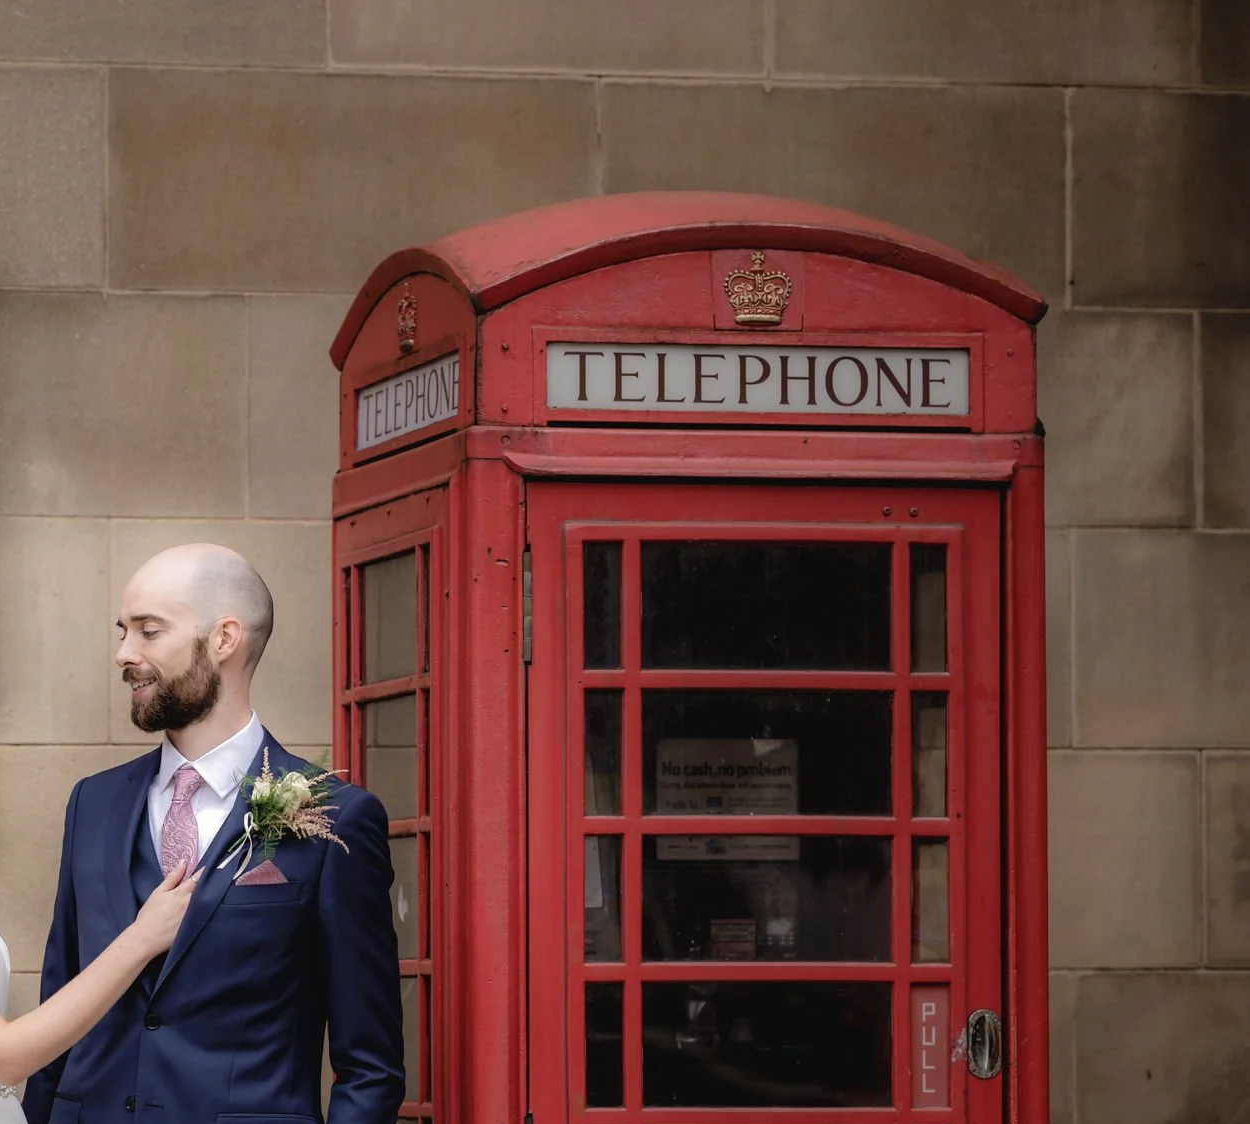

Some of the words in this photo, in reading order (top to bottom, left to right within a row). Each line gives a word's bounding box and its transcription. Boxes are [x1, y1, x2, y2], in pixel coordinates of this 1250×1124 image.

[363, 360, 460, 442] TELEPHONE
[563, 350, 952, 408] TELEPHONE
[661, 761, 681, 777] No
[683, 761, 717, 778] cash,
[718, 764, 735, 777] no
[736, 761, 792, 778] problem
[922, 1002, 936, 1093] PULL
